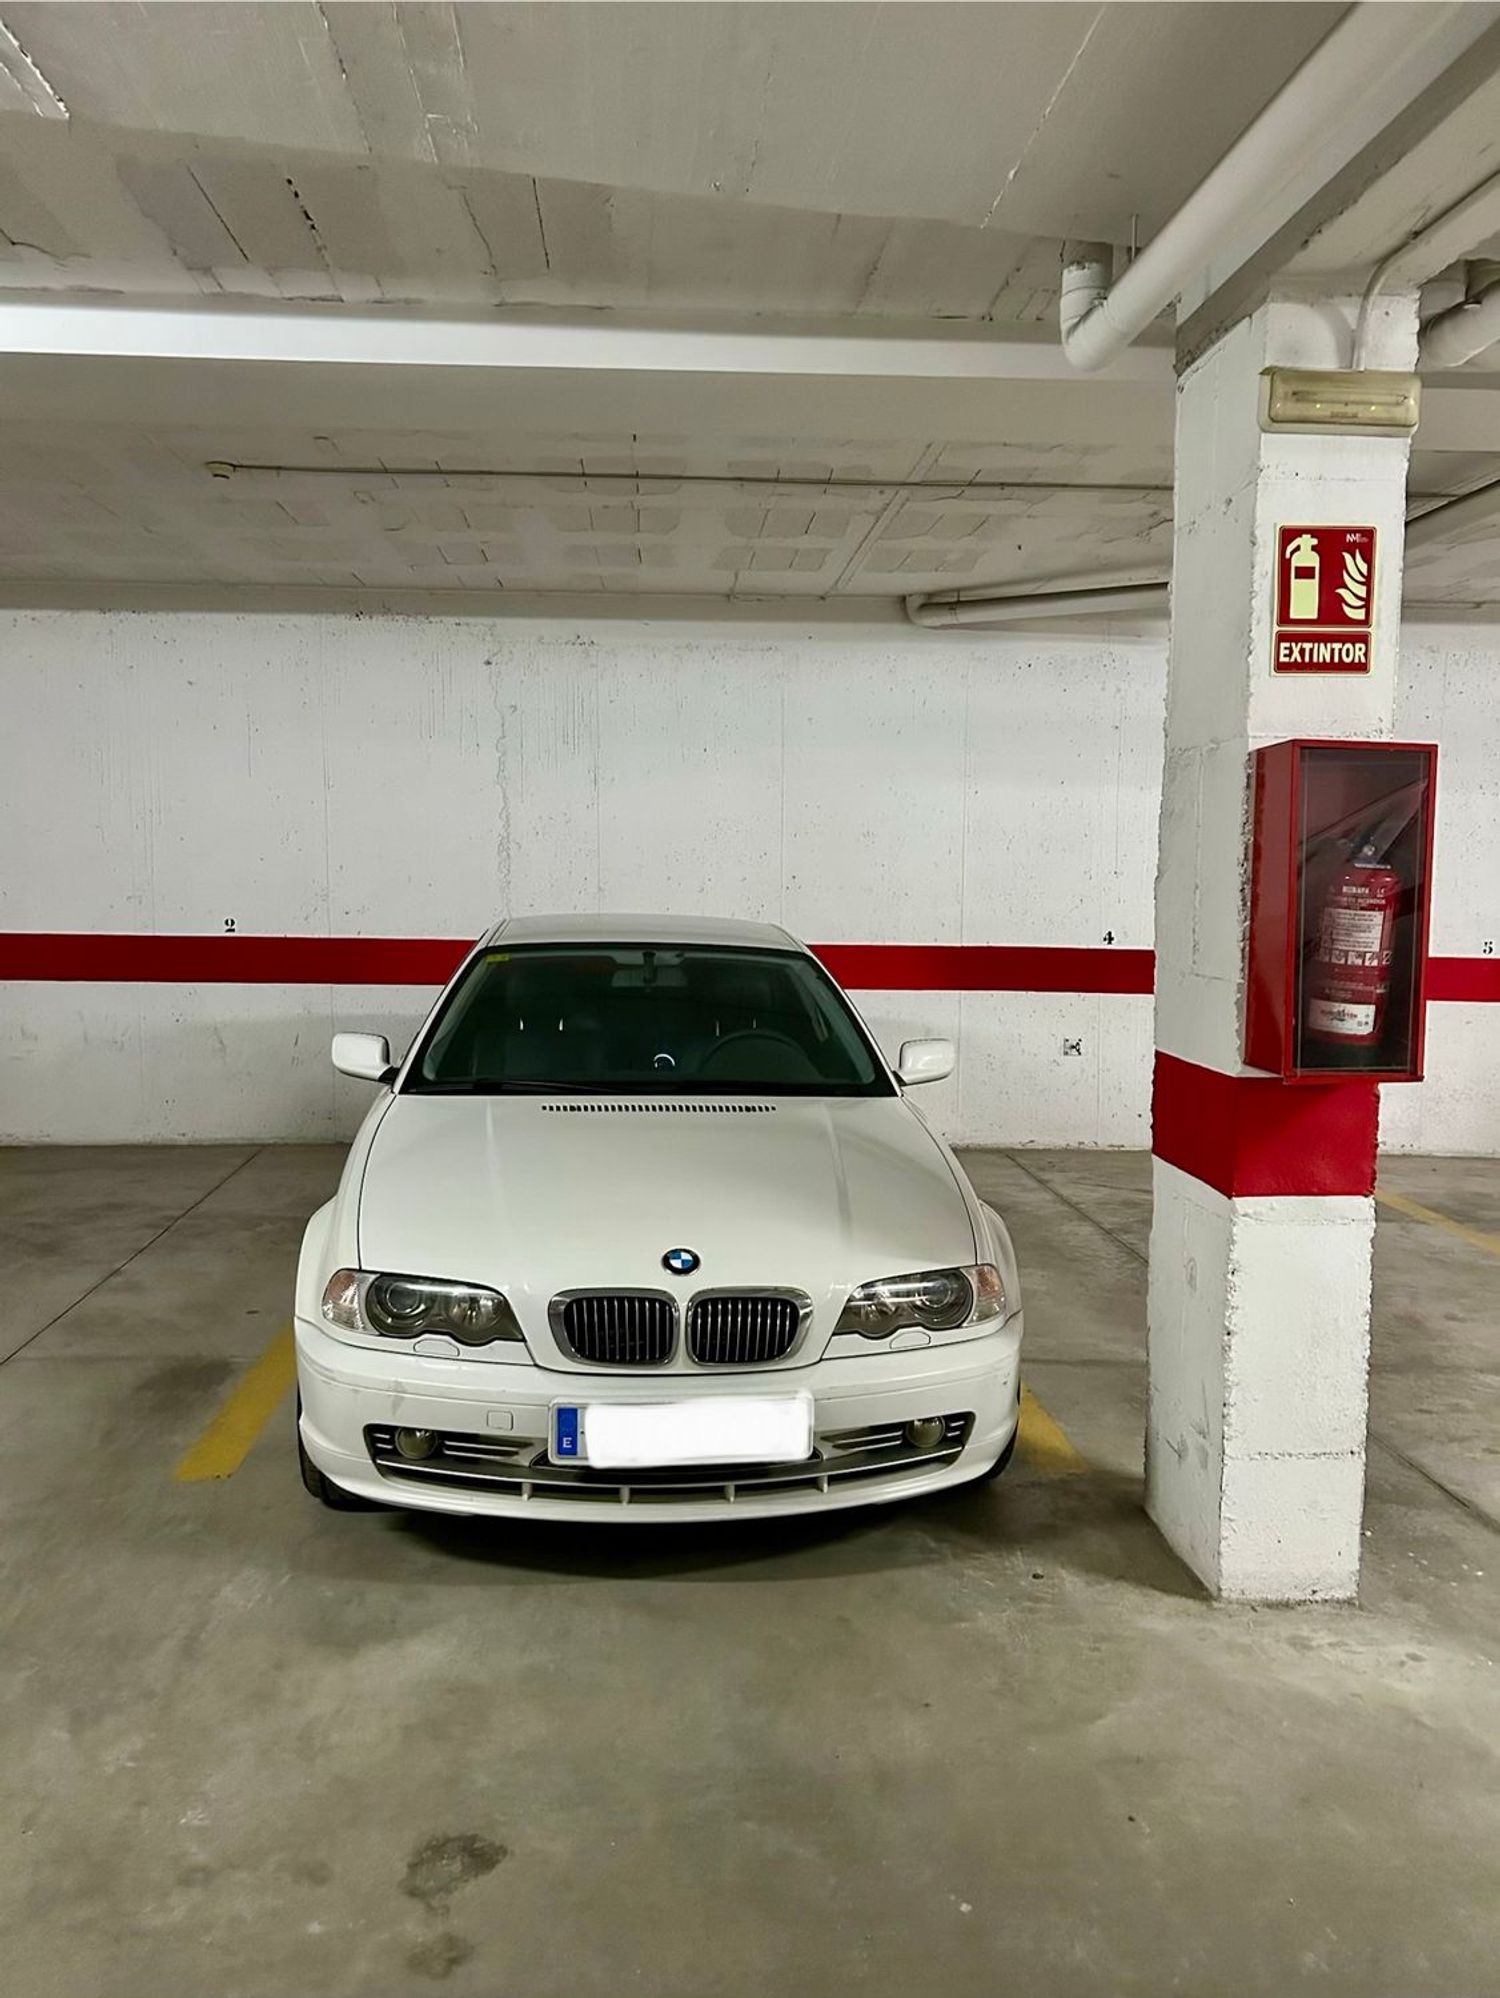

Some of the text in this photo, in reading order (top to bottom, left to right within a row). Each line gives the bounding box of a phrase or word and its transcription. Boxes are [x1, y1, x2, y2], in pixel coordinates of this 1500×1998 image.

[1279, 642, 1366, 663] EXTINTOR
[225, 918, 236, 933] 2
[1103, 930, 1115, 945] 4
[1483, 941, 1493, 954] 5
[563, 1437, 572, 1448] E
